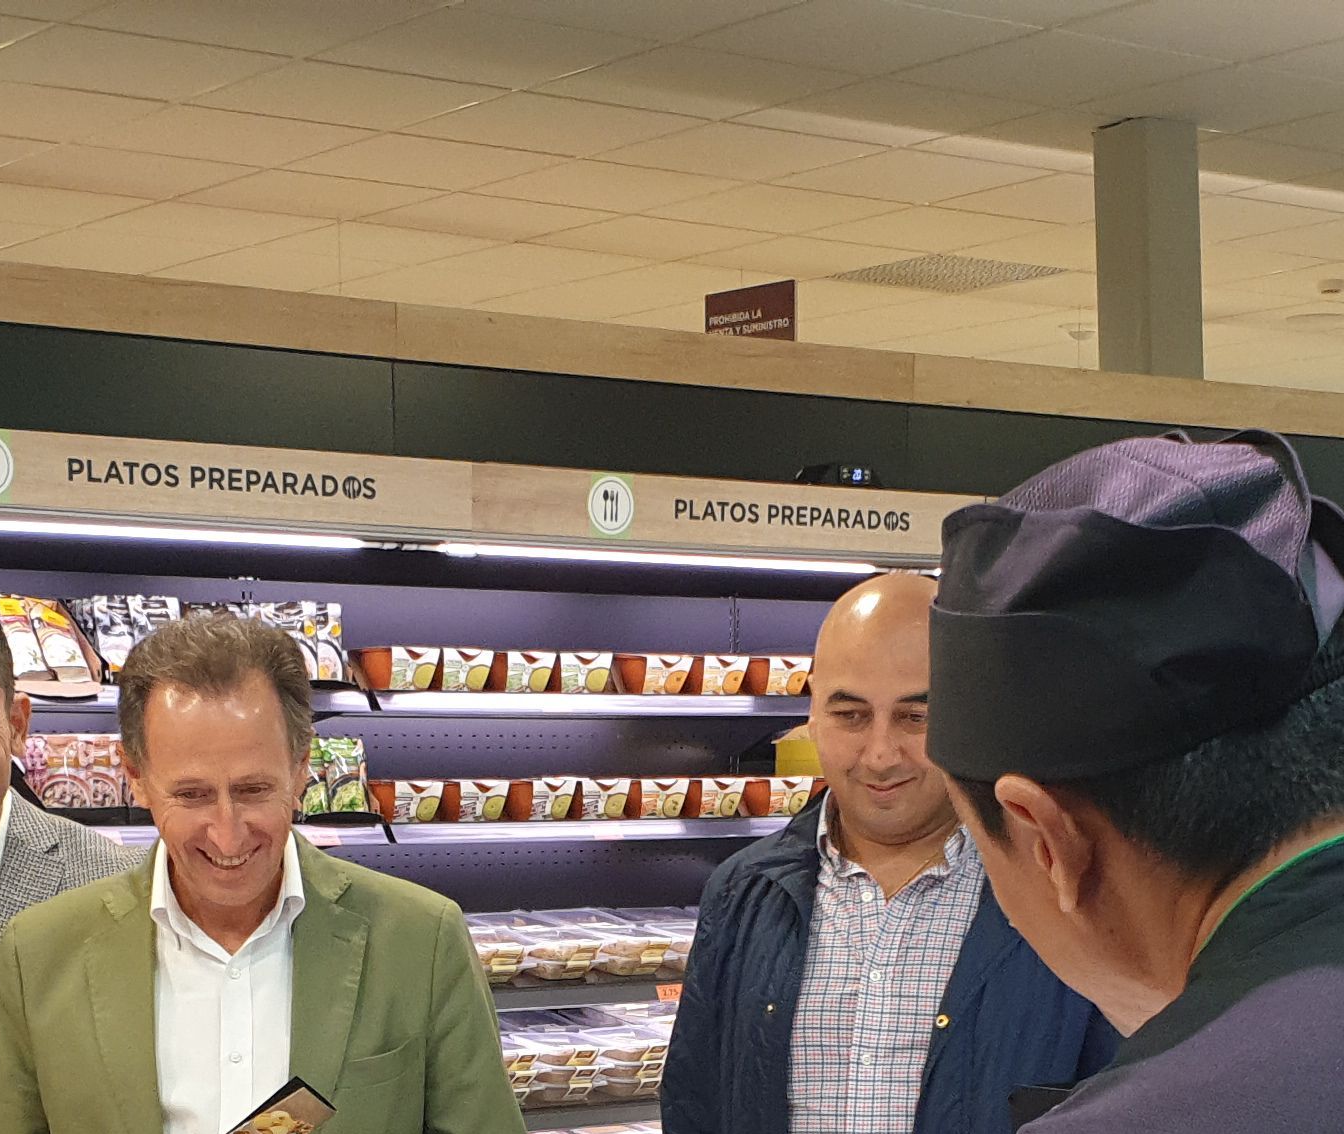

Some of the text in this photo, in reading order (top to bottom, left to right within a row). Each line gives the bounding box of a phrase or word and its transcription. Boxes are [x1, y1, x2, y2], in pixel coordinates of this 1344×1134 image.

[709, 308, 762, 326] PROHIBIDA LA
[736, 326, 742, 335] Y
[743, 318, 790, 334] SUMINISTRO
[67, 458, 377, 500] PLATOS PREPARADOS
[674, 499, 911, 531] PLATOS PREPARADOS
